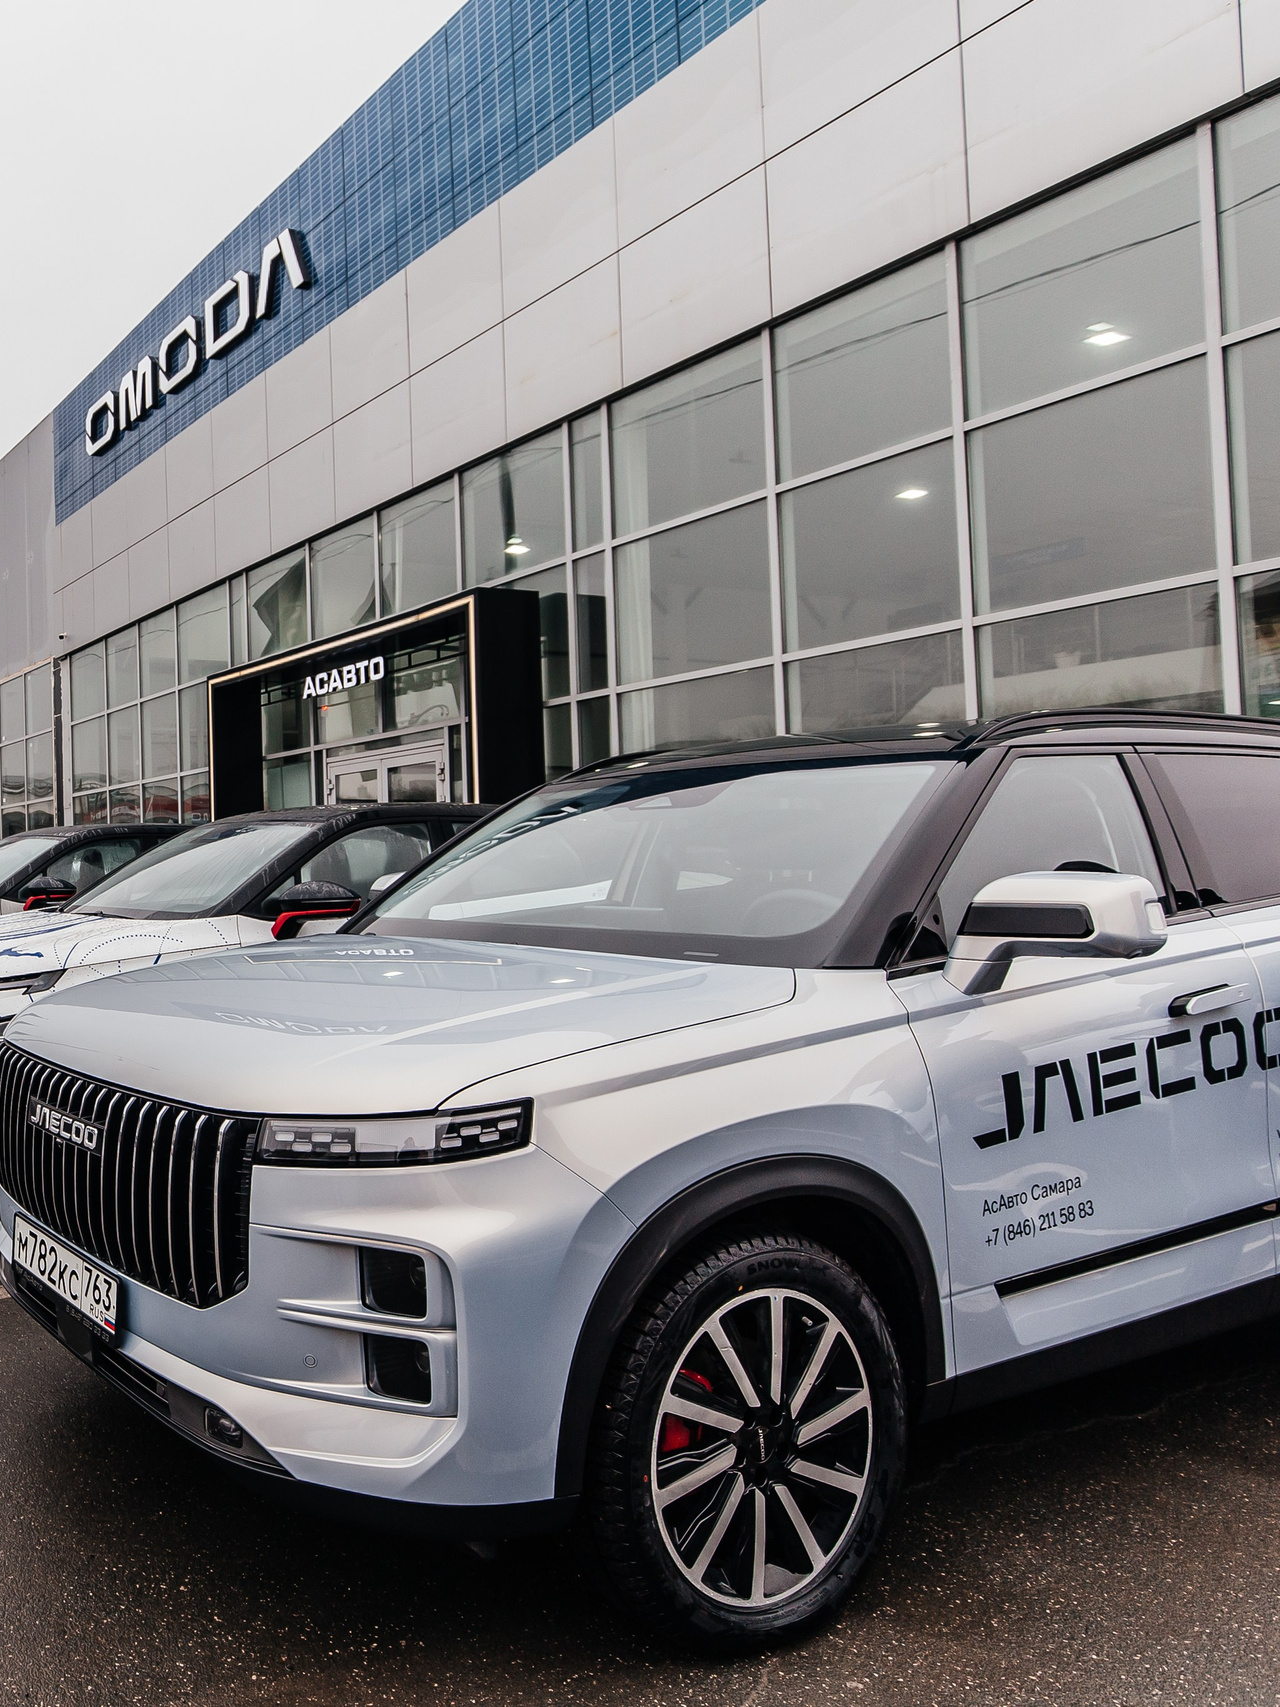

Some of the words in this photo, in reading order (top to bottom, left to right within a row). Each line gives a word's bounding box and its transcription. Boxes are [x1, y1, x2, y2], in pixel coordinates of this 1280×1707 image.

[85, 228, 309, 456] OMODA
[302, 655, 385, 700] АСАВТО
[30, 1104, 98, 1150] JAECOO
[982, 1191, 1028, 1217] АсАвто
[1030, 1175, 1082, 1201] Самара
[985, 1227, 1000, 1248] +7
[1003, 1216, 1036, 1247] (846)
[1038, 1210, 1058, 1232] 211
[1059, 1204, 1076, 1226] 58
[1078, 1200, 1095, 1220] 83
[84, 1265, 112, 1312] 763
[89, 1303, 104, 1322] RUS
